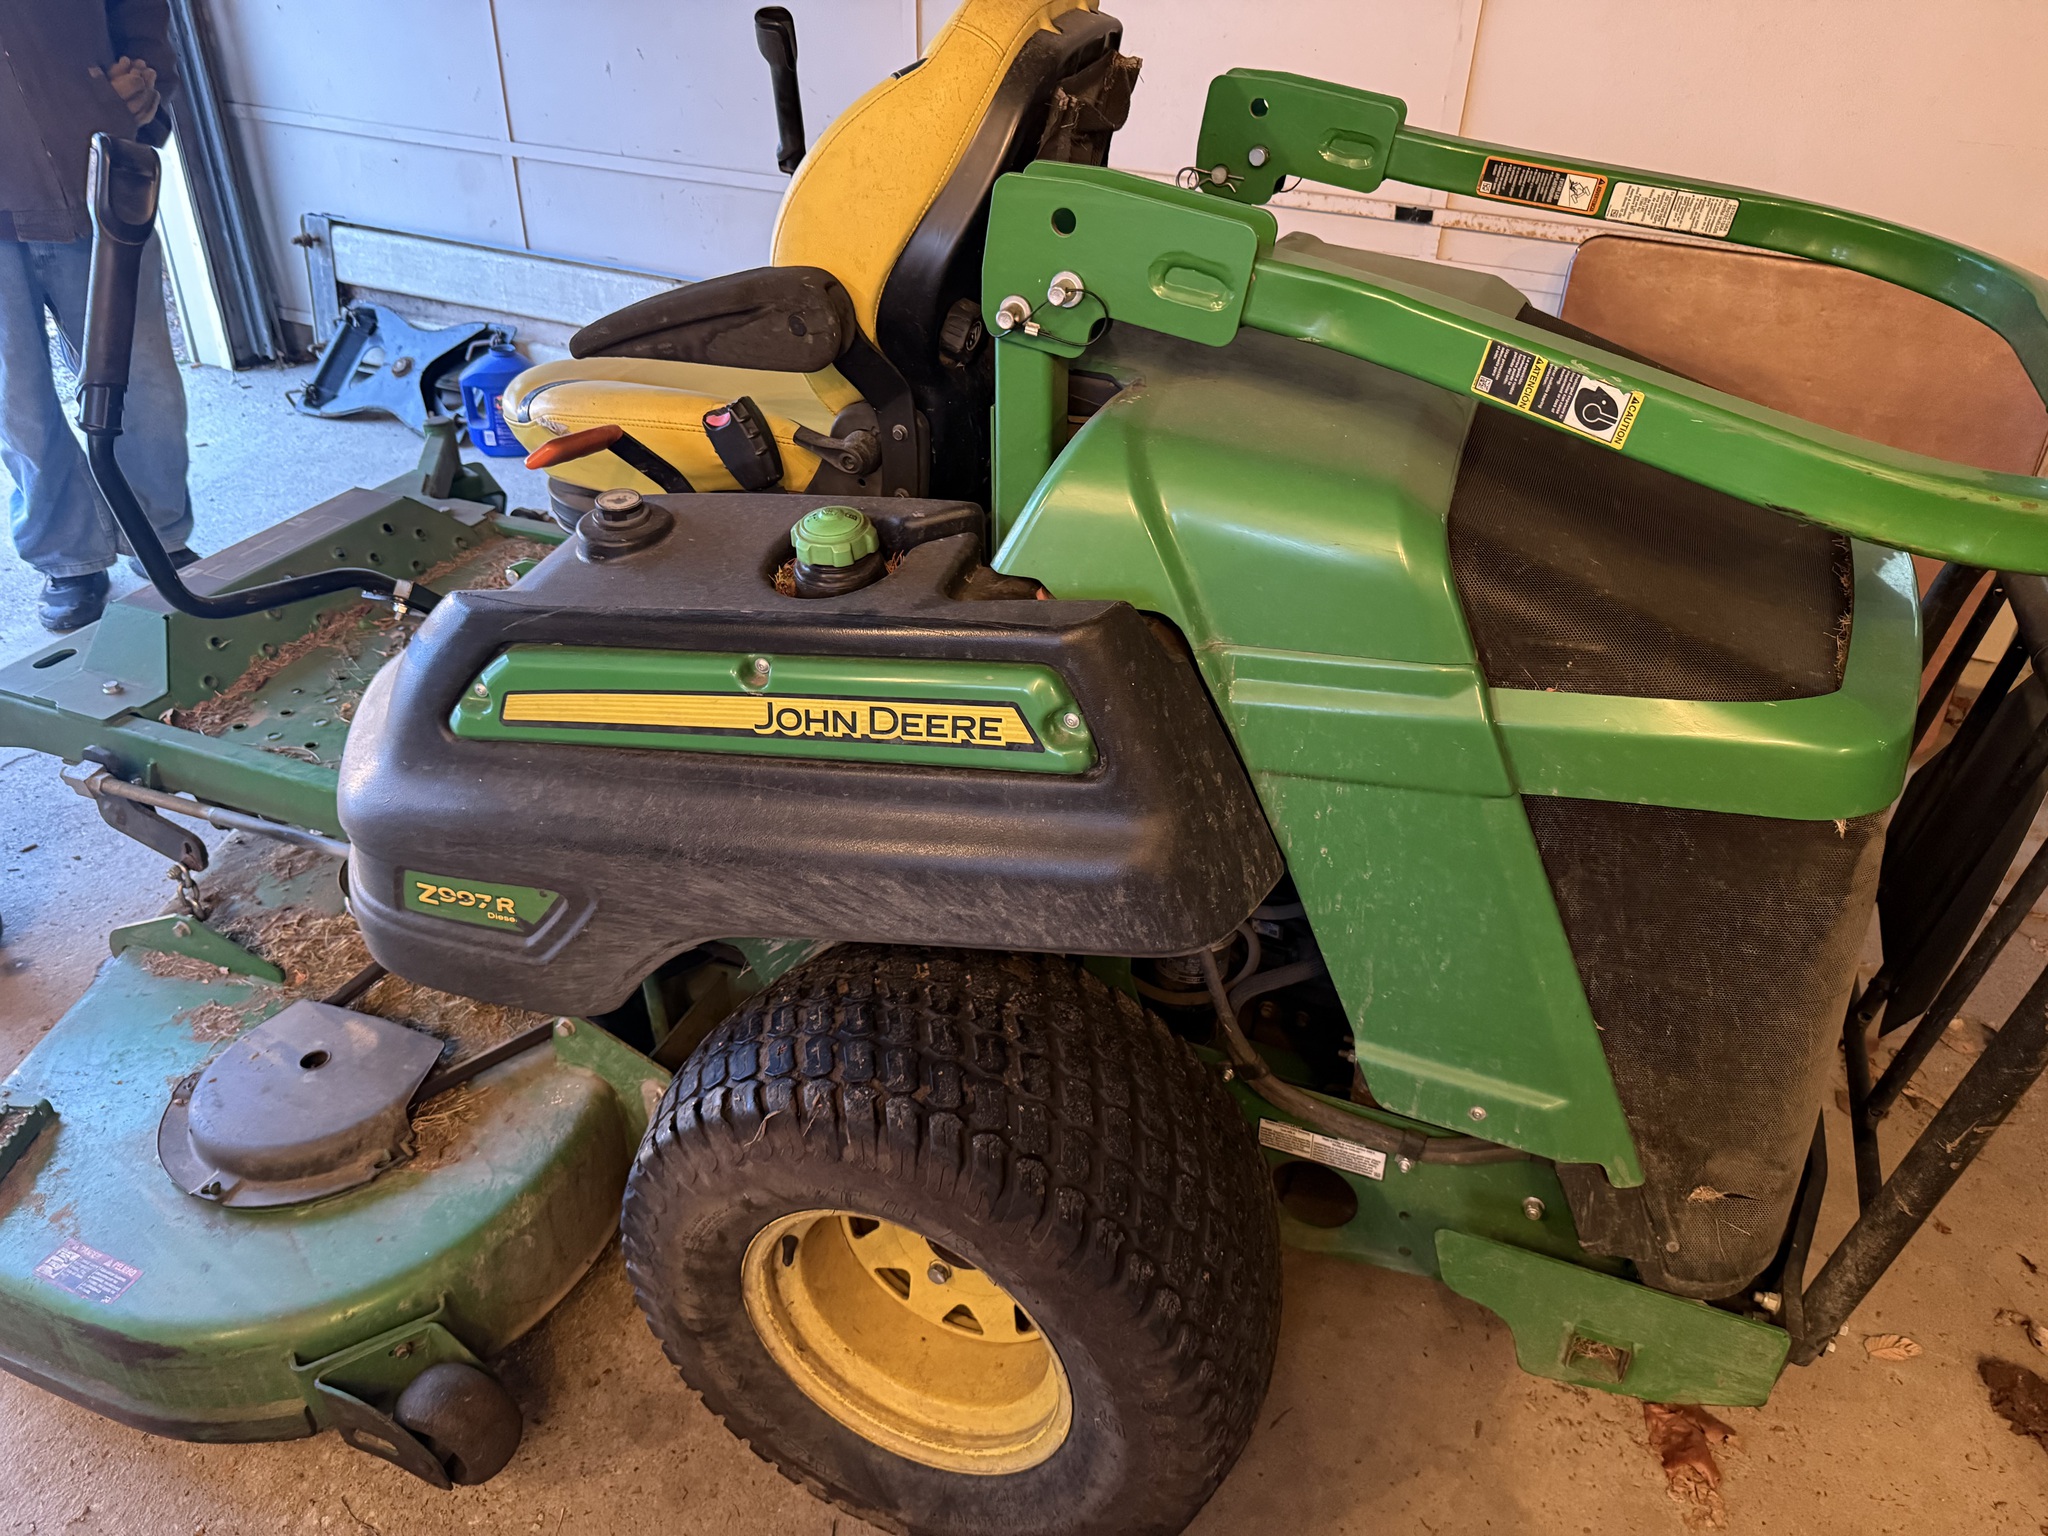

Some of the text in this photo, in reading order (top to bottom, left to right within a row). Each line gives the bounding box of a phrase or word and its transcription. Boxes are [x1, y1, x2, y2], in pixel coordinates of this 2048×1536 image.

[1519, 365, 1542, 410] ATENCIÓN
[1614, 404, 1637, 444] CAUTION
[754, 701, 1004, 743] JOHN DEERE
[487, 911, 518, 923] Diese
